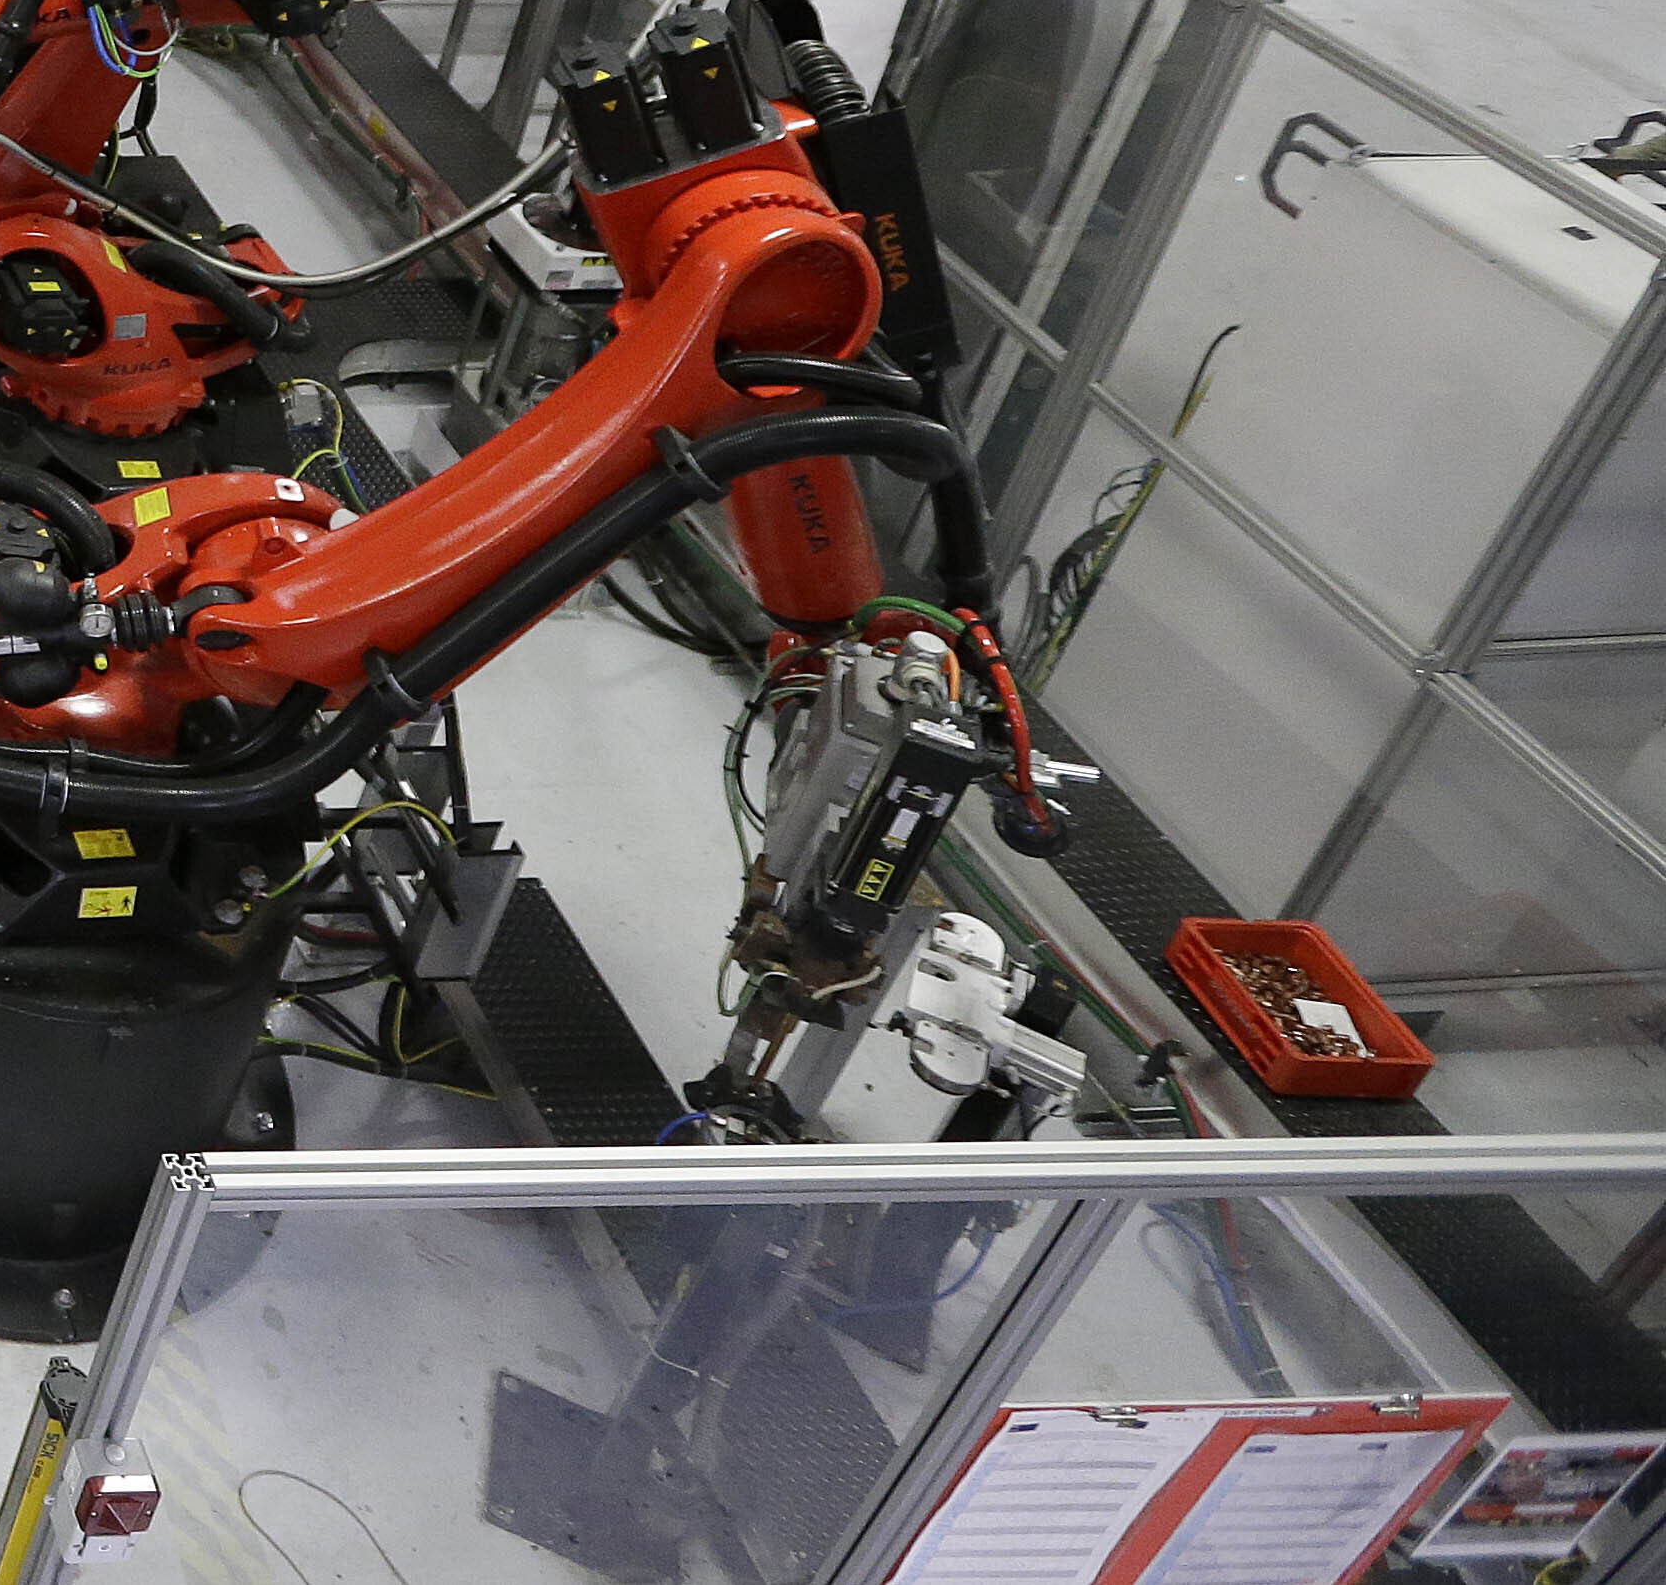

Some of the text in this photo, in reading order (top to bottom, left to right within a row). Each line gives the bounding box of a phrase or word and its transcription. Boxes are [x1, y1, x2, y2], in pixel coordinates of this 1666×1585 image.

[875, 214, 910, 291] KUKA
[788, 474, 832, 554] KUKA
[40, 1433, 60, 1459] SICK
